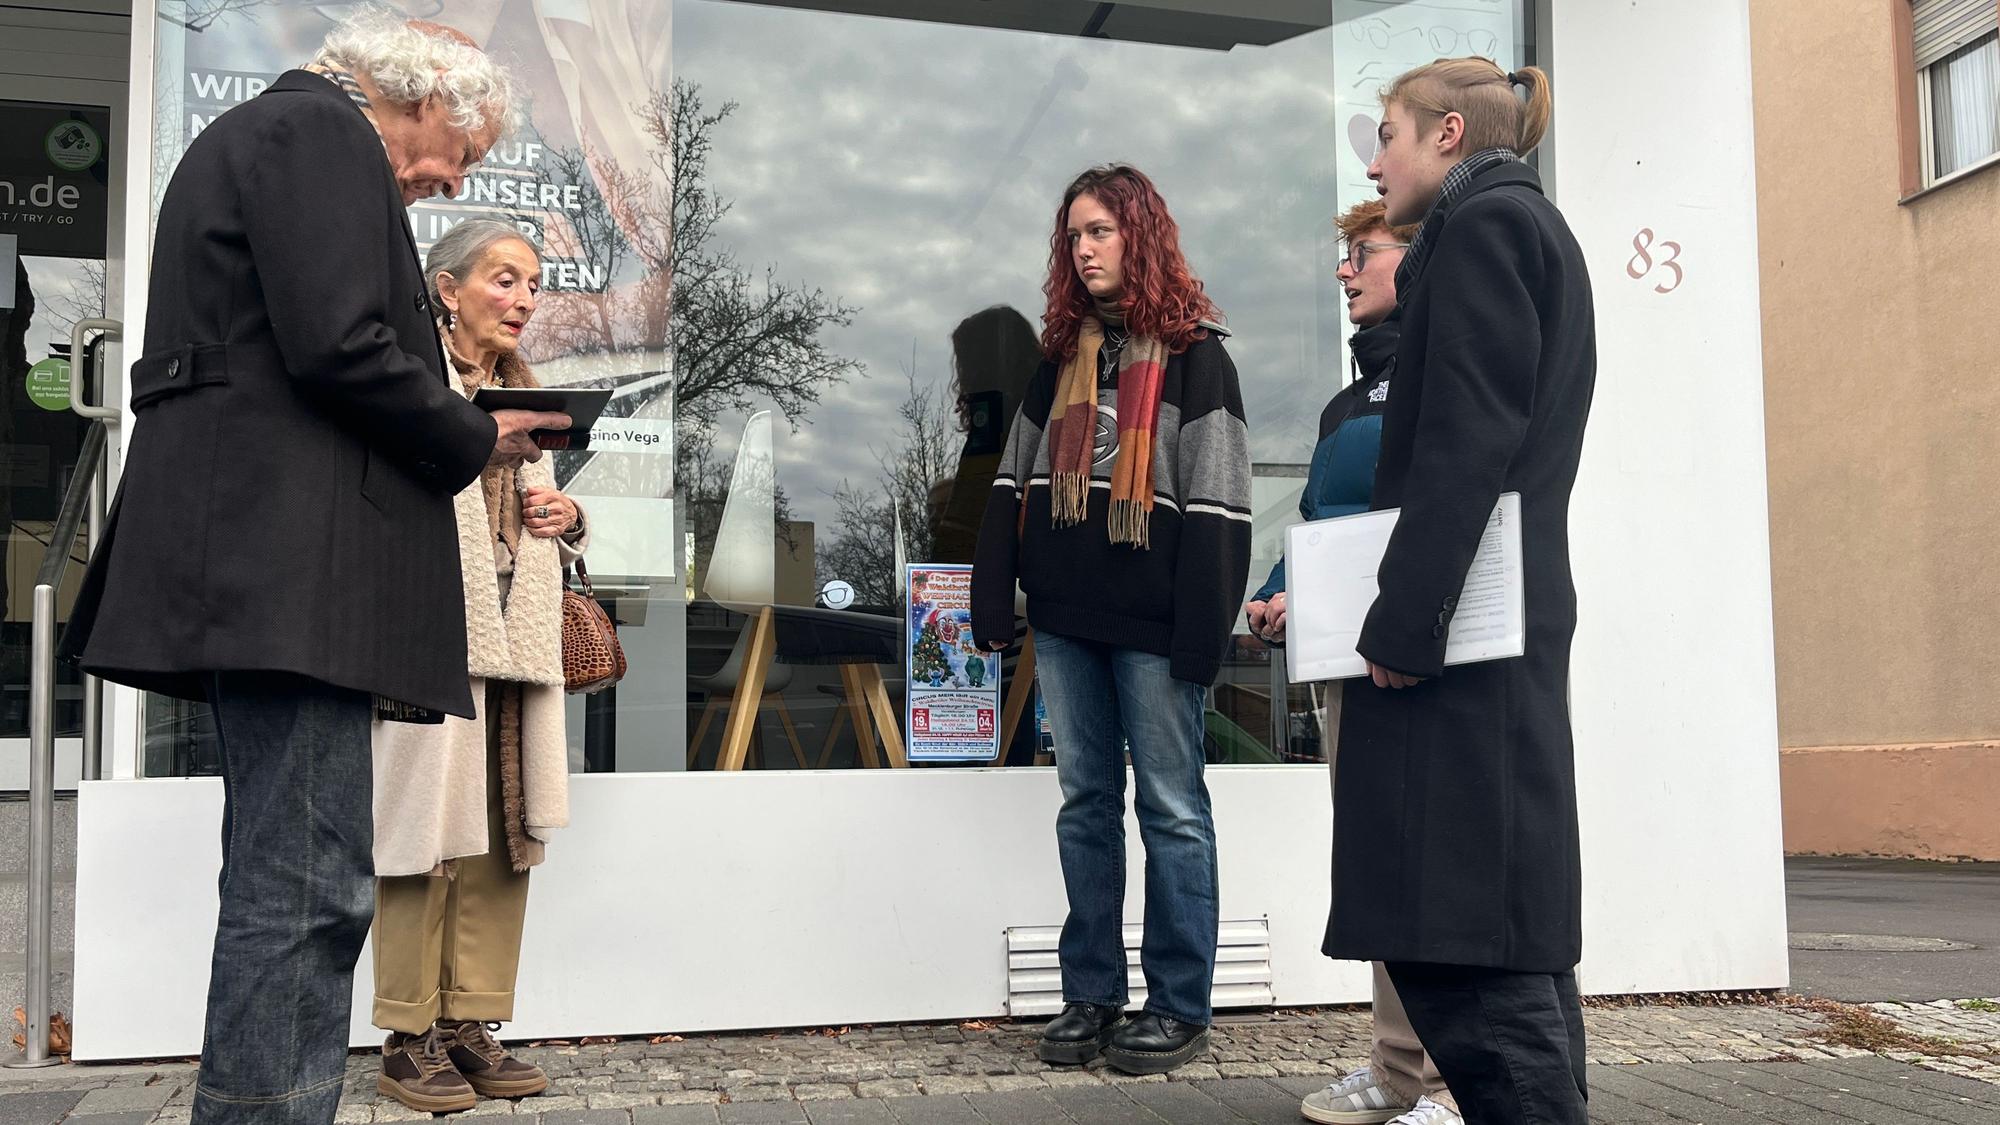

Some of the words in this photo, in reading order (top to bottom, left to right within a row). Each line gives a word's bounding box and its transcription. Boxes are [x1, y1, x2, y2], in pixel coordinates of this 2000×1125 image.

[453, 177, 582, 209] UNSERE
[22, 213, 43, 223] TRY
[57, 216, 74, 225] GO
[1626, 228, 1683, 293] 83
[624, 430, 660, 445] Vega
[911, 694, 937, 702] CIRCUS
[914, 716, 928, 726] 19.
[978, 717, 993, 727] 04.
